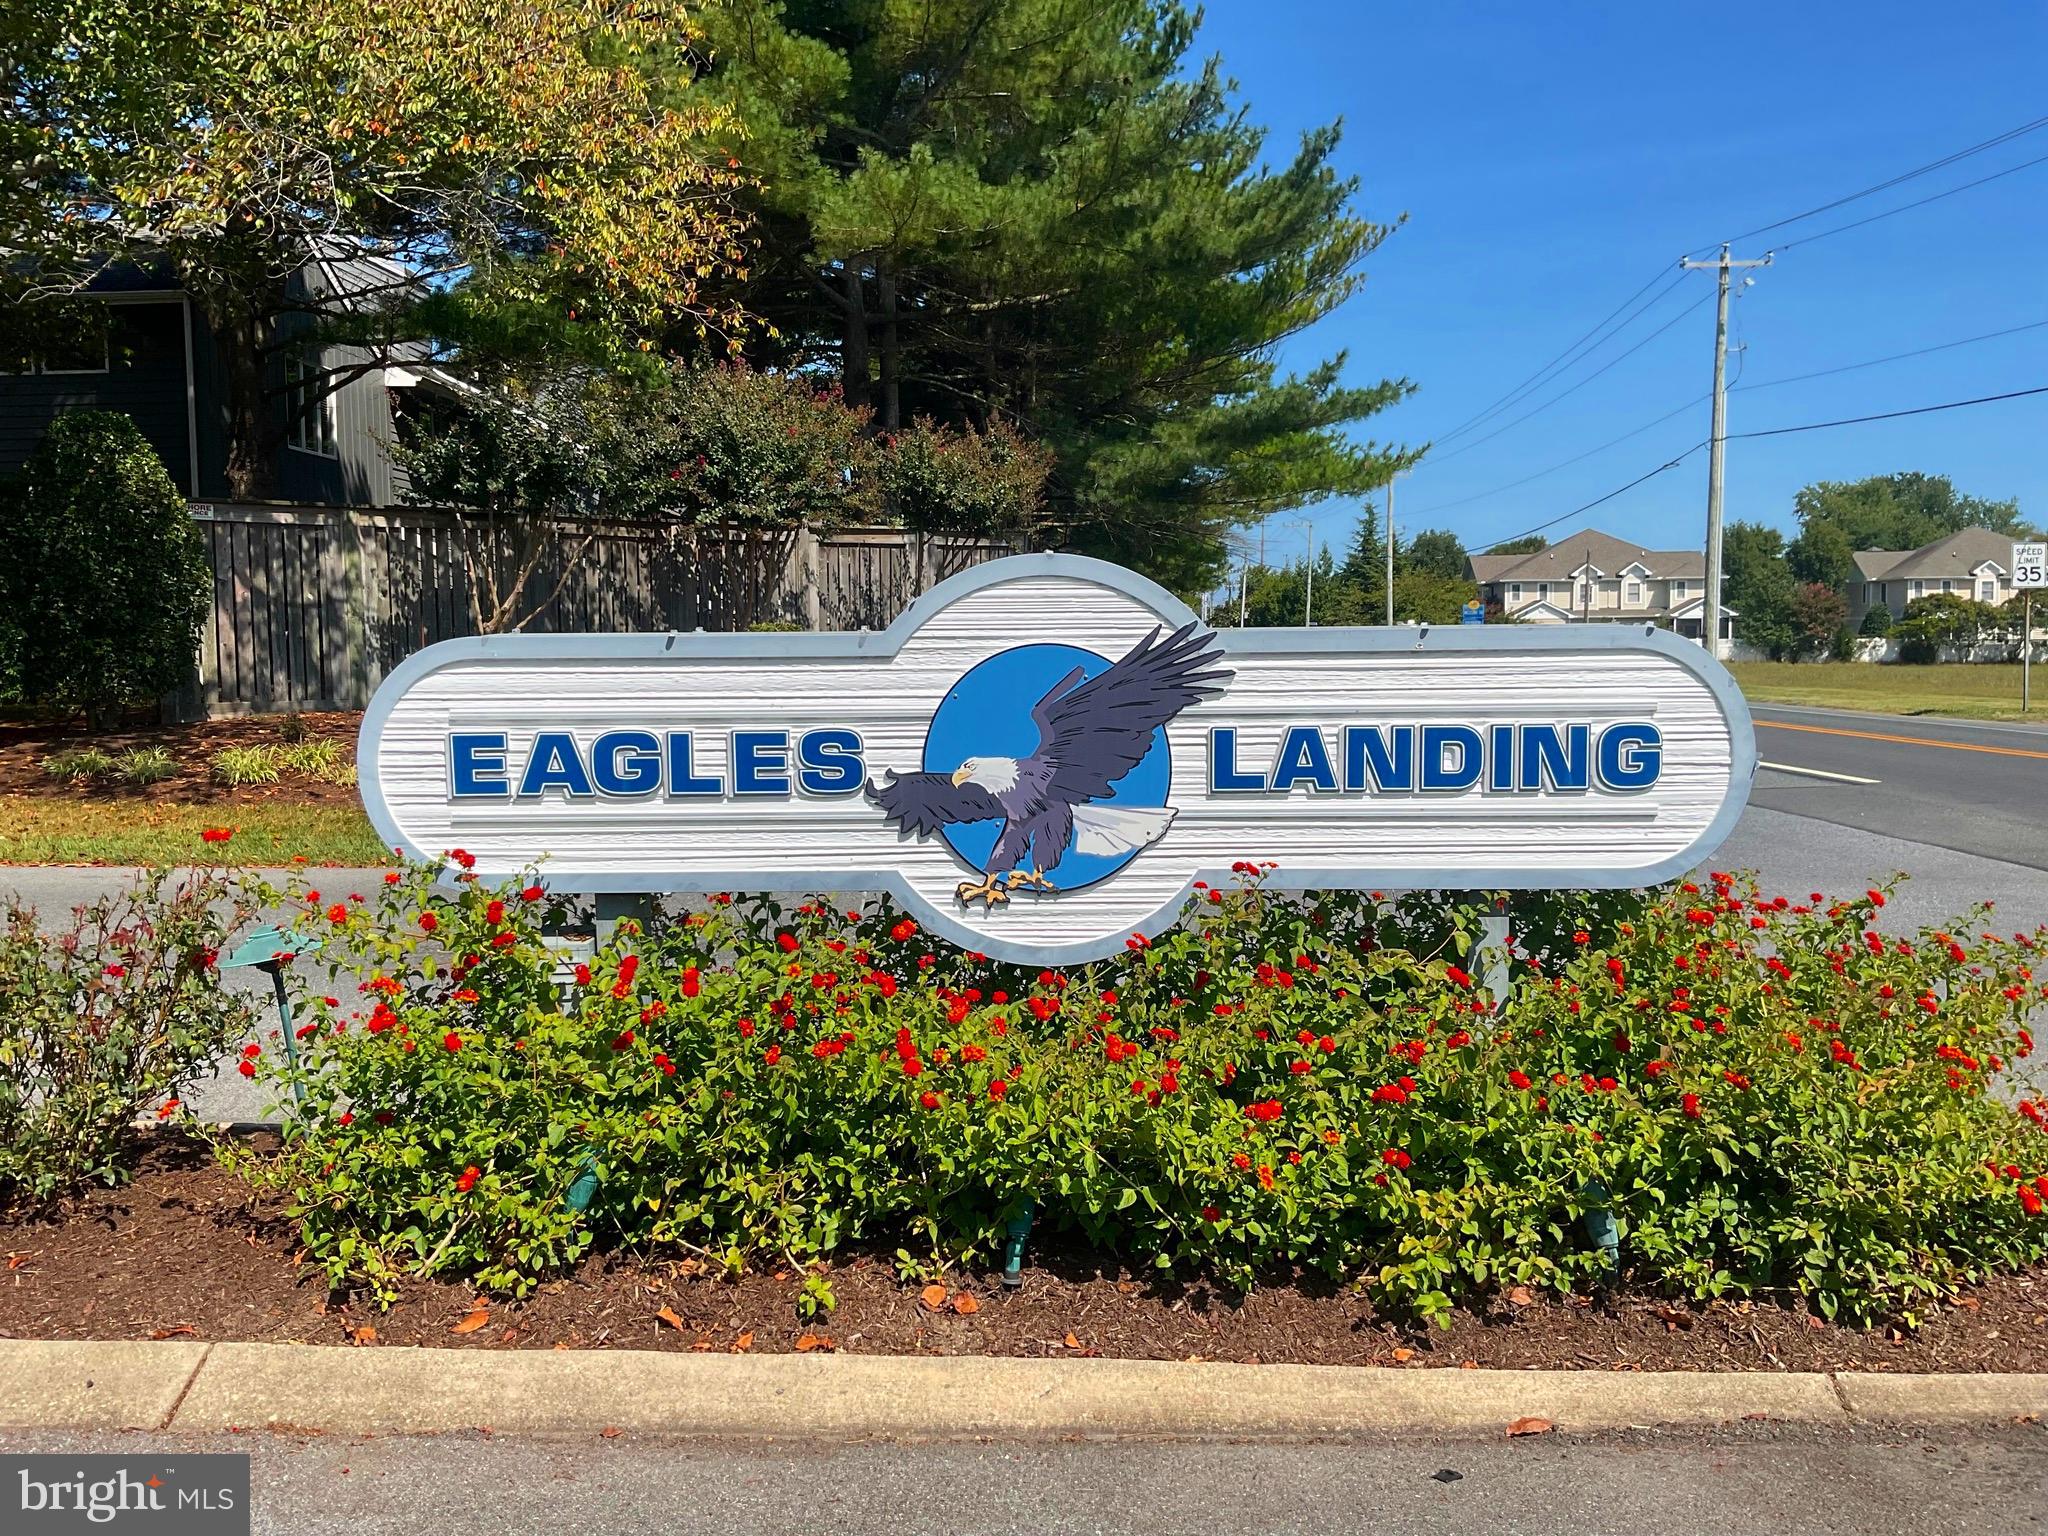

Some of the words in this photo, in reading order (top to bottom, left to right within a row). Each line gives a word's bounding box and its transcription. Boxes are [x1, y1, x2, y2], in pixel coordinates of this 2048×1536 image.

[2017, 566, 2041, 582] 35
[448, 729, 866, 797] EAGLES
[1209, 722, 1664, 793] LANDING
